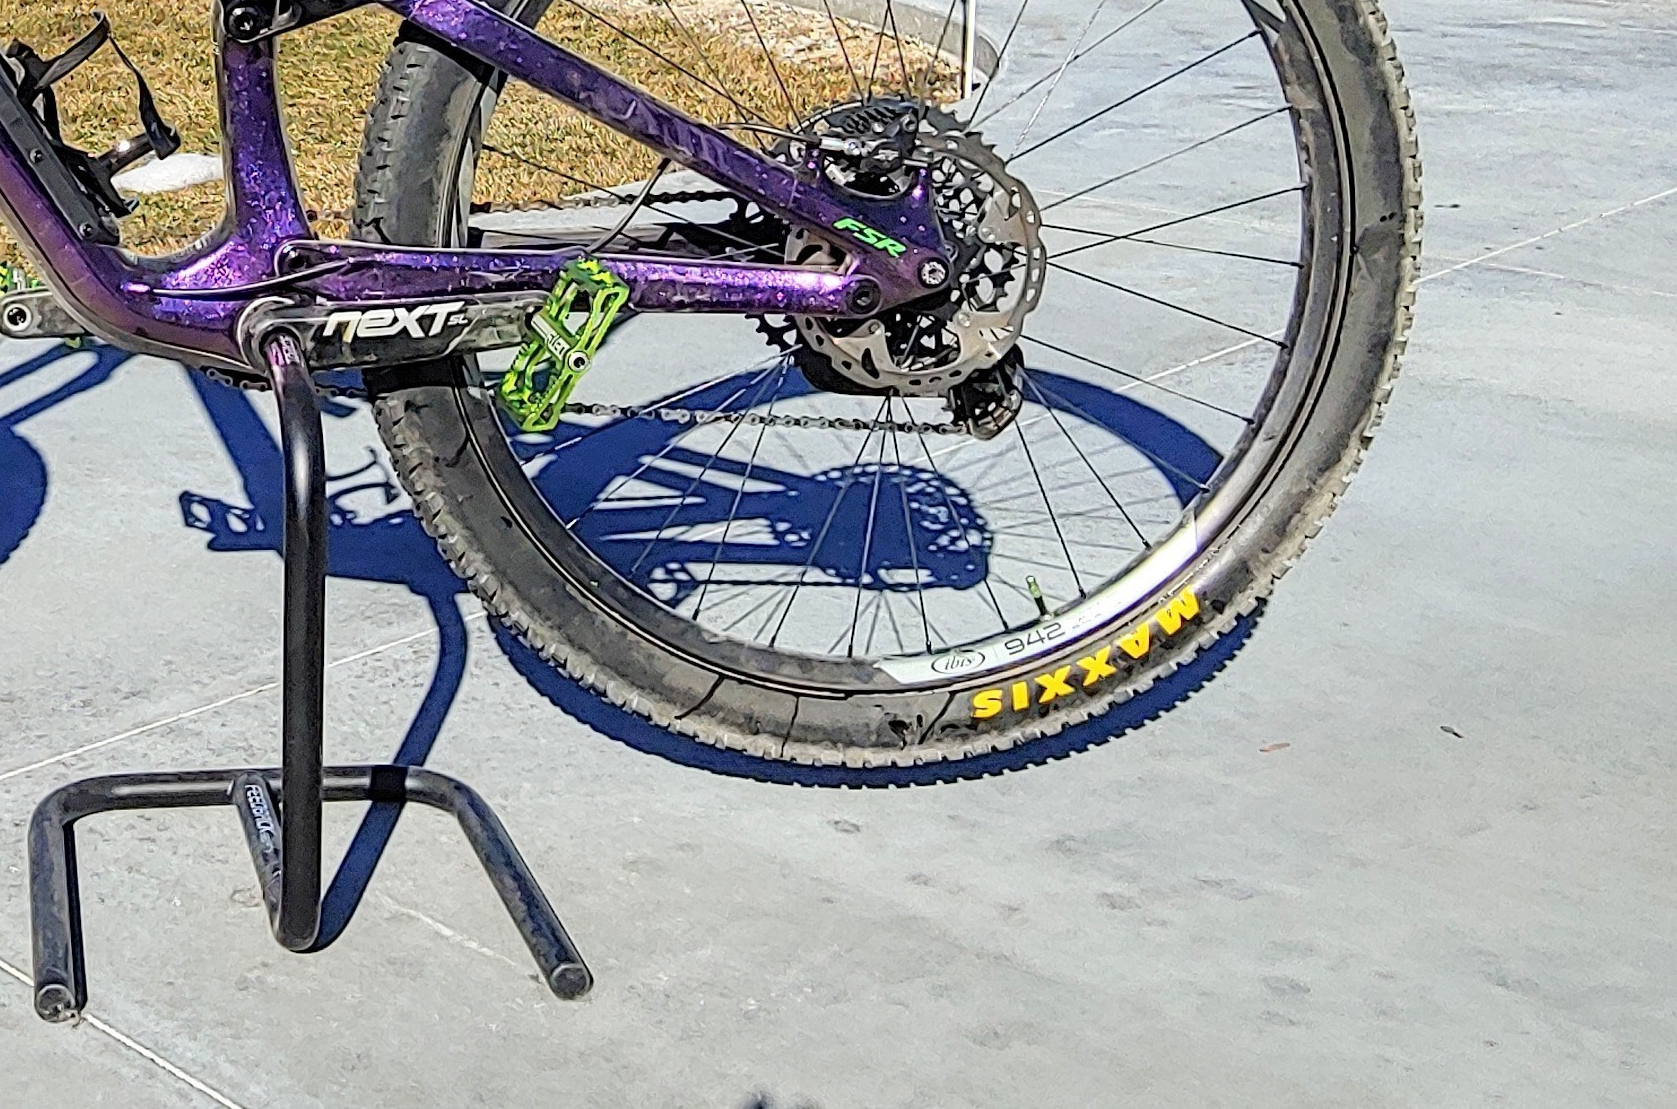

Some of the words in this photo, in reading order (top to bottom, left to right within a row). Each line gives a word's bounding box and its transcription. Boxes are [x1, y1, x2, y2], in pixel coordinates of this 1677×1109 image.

[833, 217, 907, 258] FSR
[972, 585, 1201, 720] MAXXIS
[1004, 622, 1066, 656] 942
